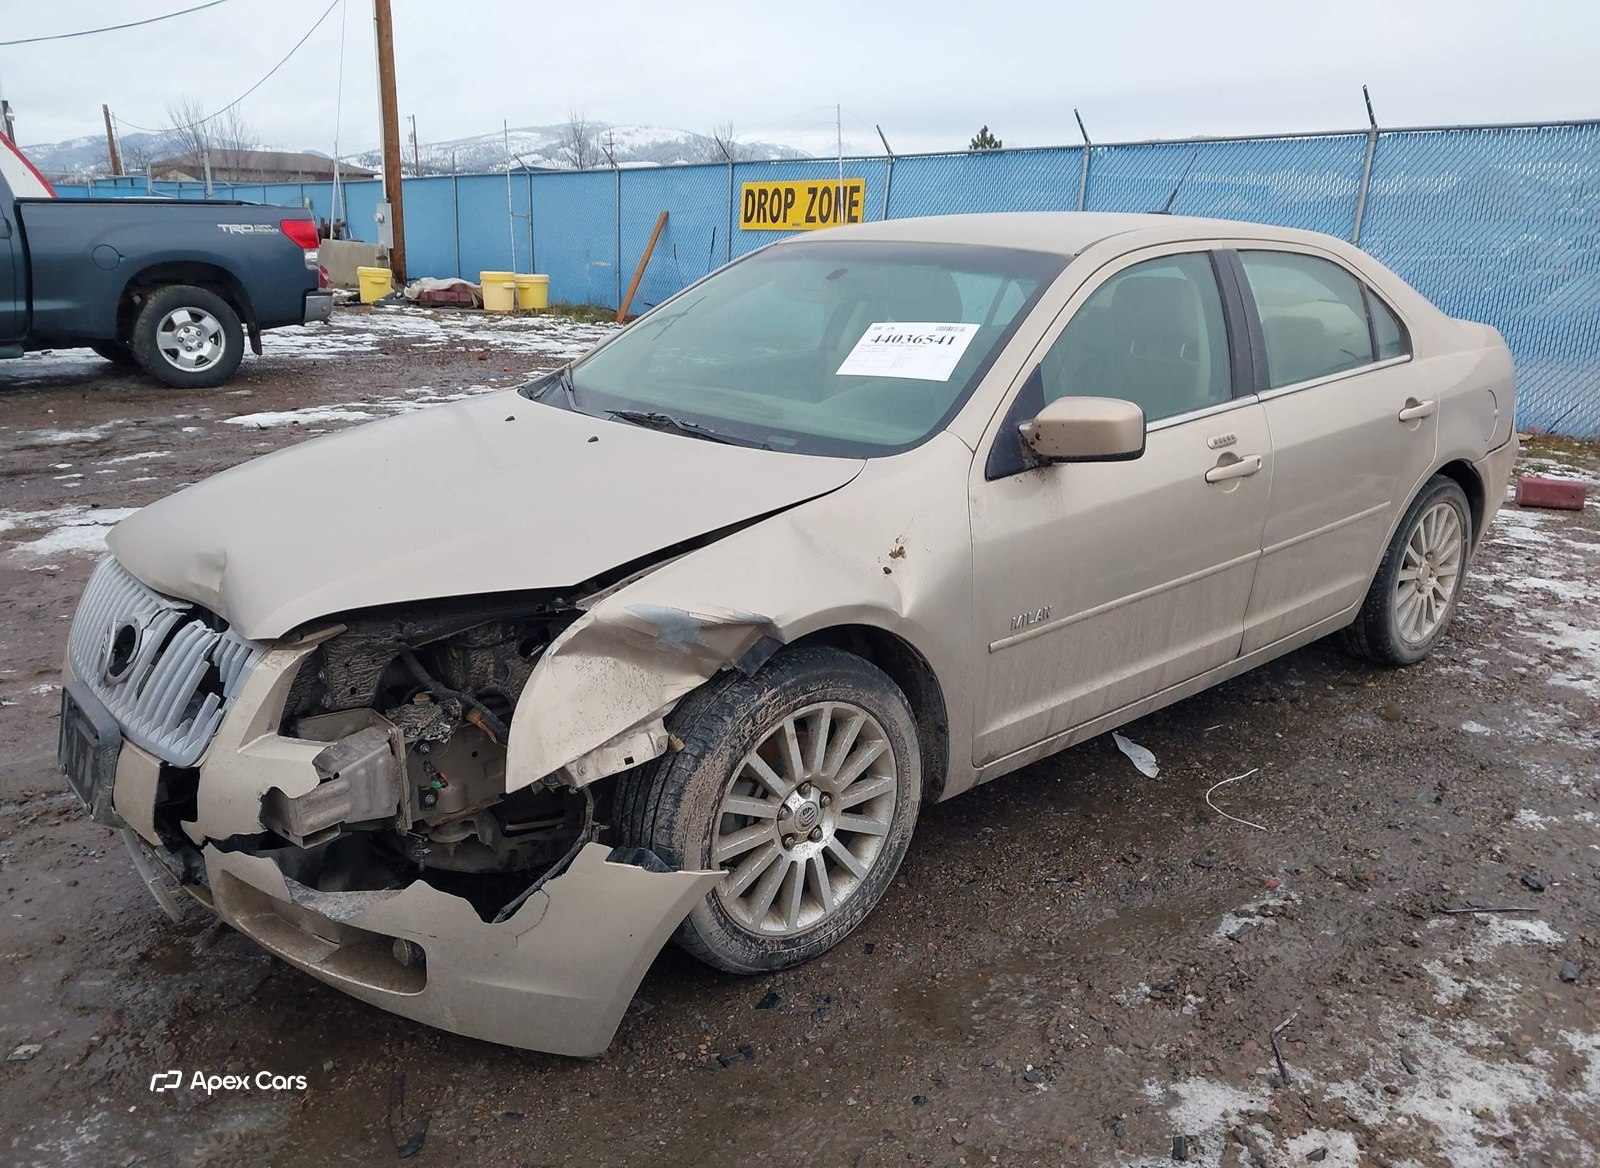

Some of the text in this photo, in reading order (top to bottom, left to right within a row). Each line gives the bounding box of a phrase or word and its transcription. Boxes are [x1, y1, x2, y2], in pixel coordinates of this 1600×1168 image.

[743, 185, 861, 224] DROP ZONE
[217, 223, 254, 235] TRD
[870, 333, 956, 346] 44036541
[1009, 605, 1053, 631] MILAN
